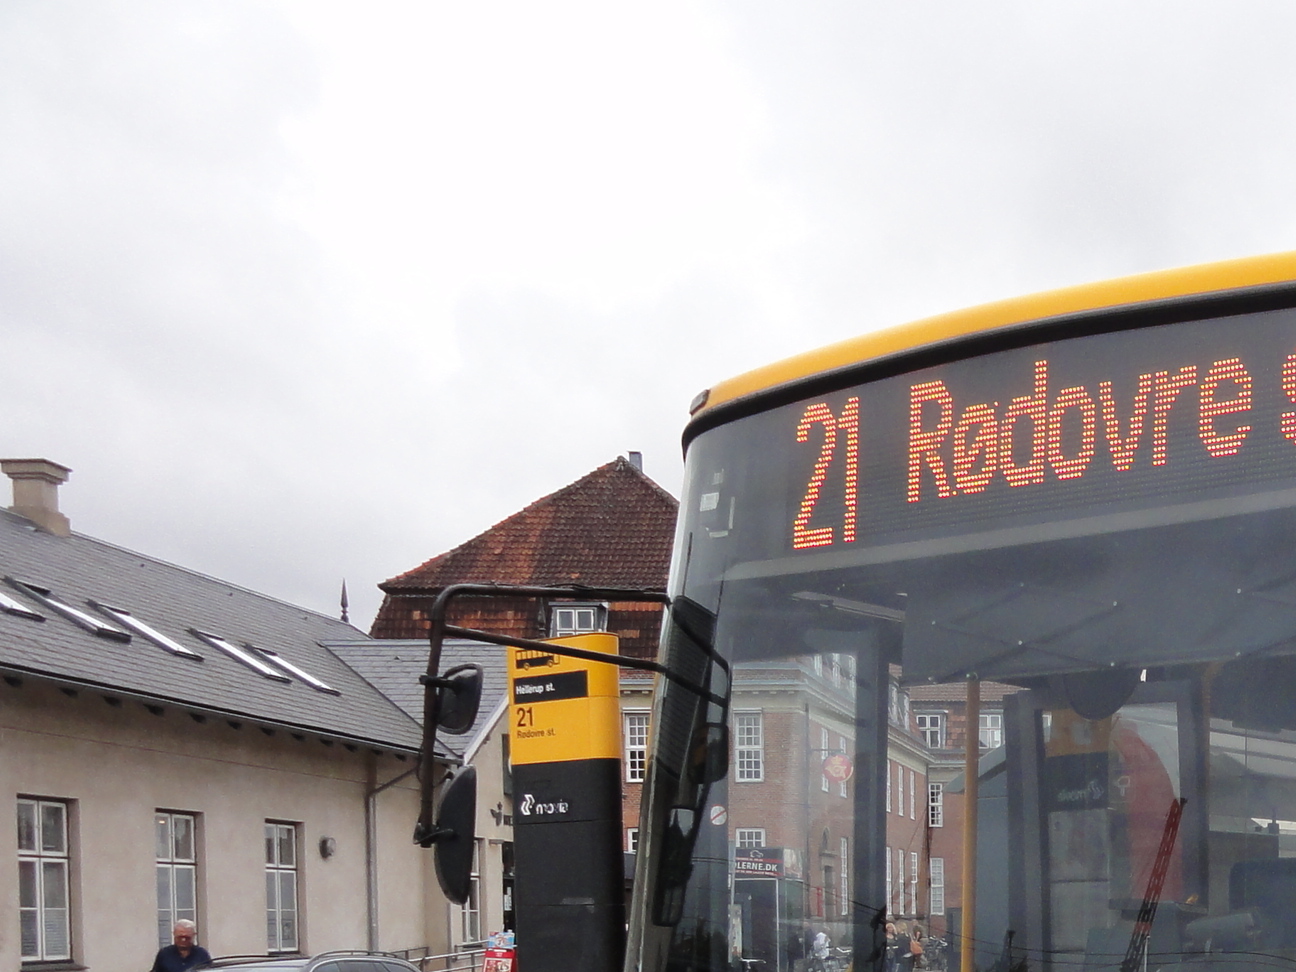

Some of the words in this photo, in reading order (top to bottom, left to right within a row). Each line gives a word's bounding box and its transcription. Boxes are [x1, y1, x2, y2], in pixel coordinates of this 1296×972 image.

[793, 396, 859, 549] 21
[907, 358, 1253, 503] Rødovre
[516, 684, 544, 695] Hellerup
[516, 707, 533, 727] 21
